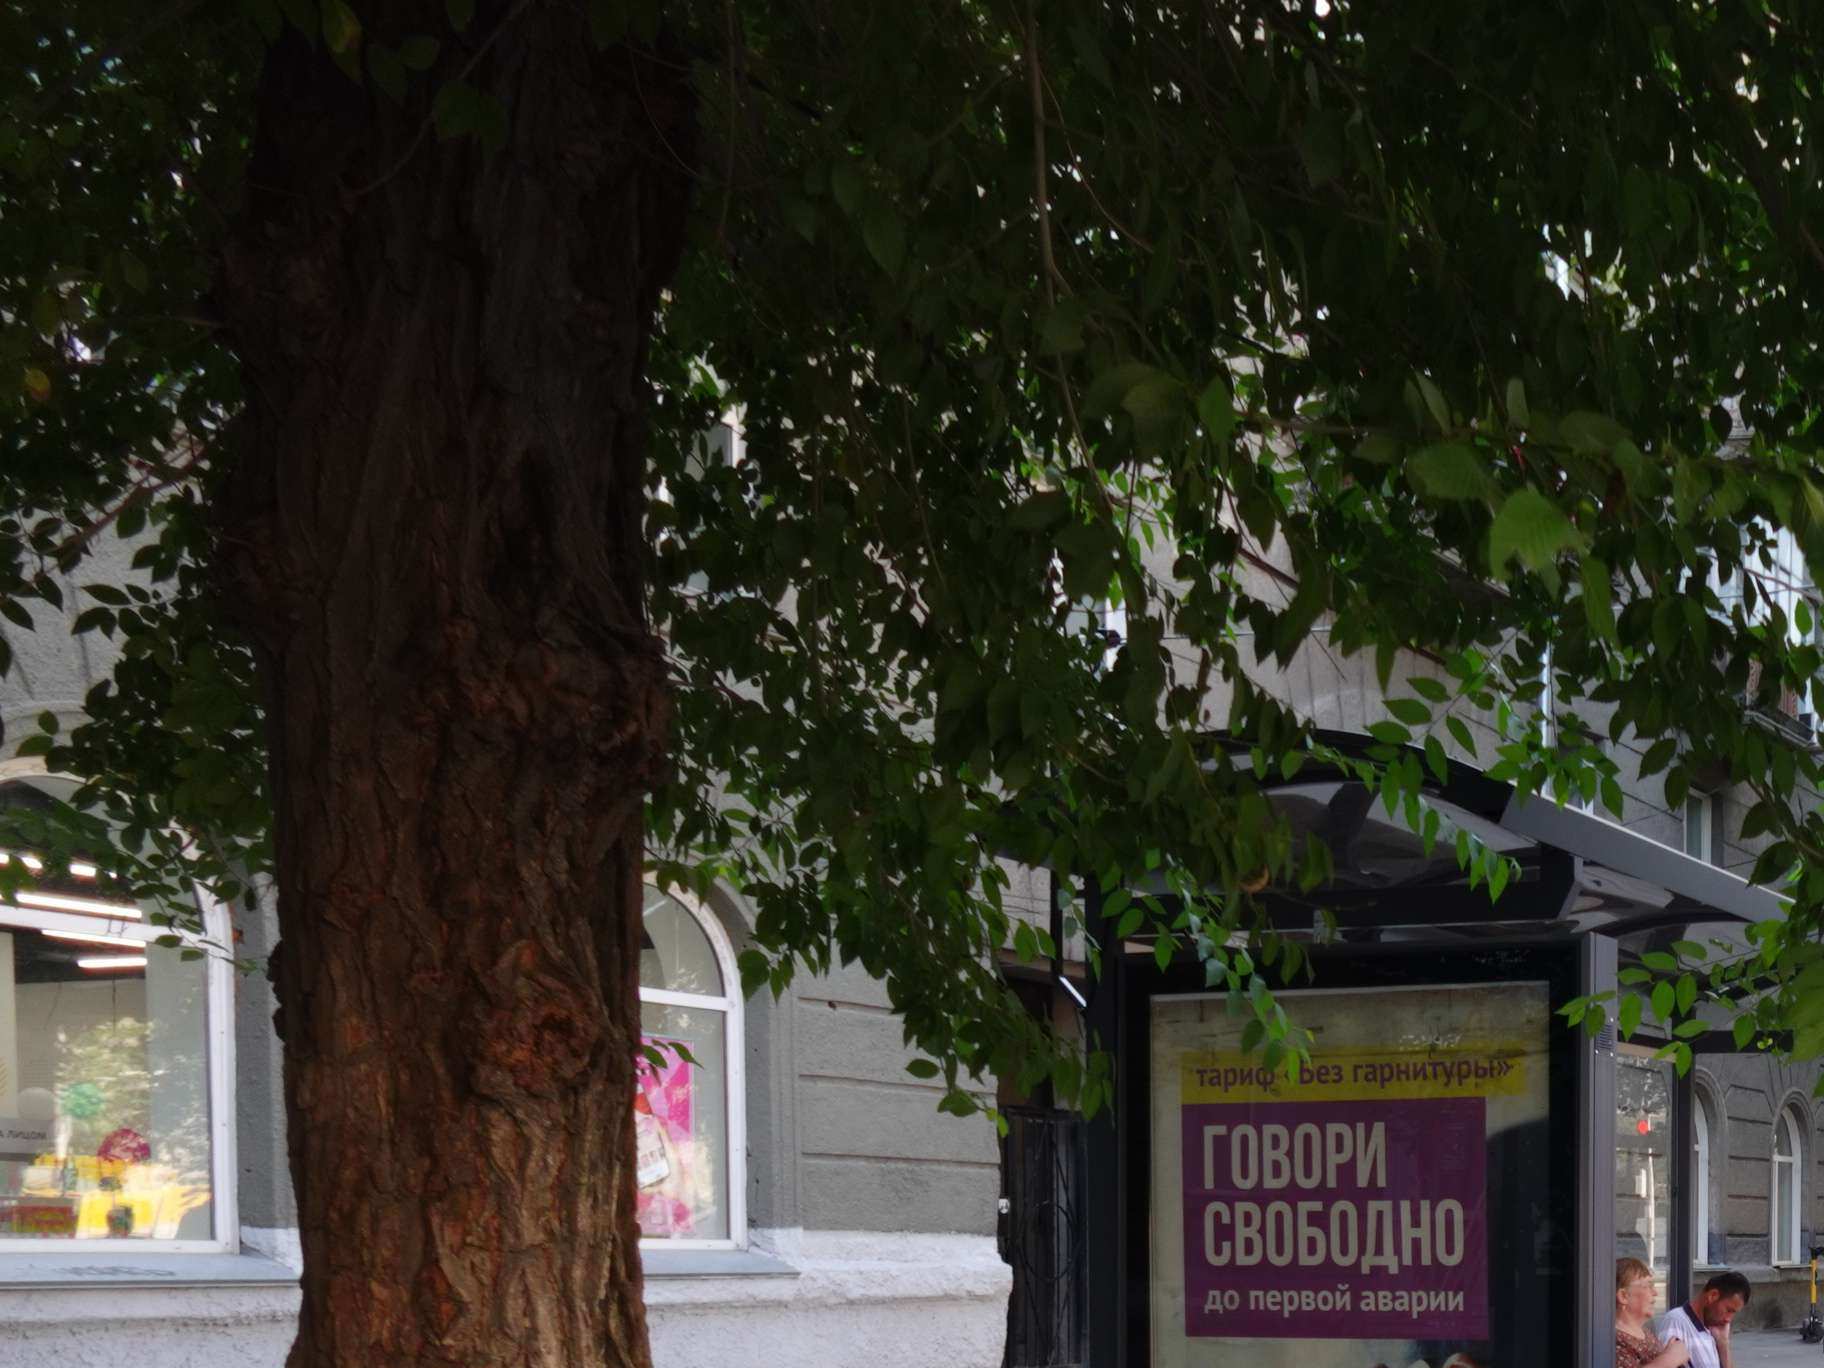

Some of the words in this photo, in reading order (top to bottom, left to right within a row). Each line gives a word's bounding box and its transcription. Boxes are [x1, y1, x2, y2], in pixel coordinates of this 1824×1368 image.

[1196, 1064, 1276, 1093] тариф
[1202, 1121, 1387, 1191] ГОВОРИ
[1203, 1198, 1466, 1275] СВОБОДНО
[1204, 1289, 1240, 1313] до
[1249, 1284, 1352, 1318] первой
[1360, 1289, 1465, 1319] аварии
